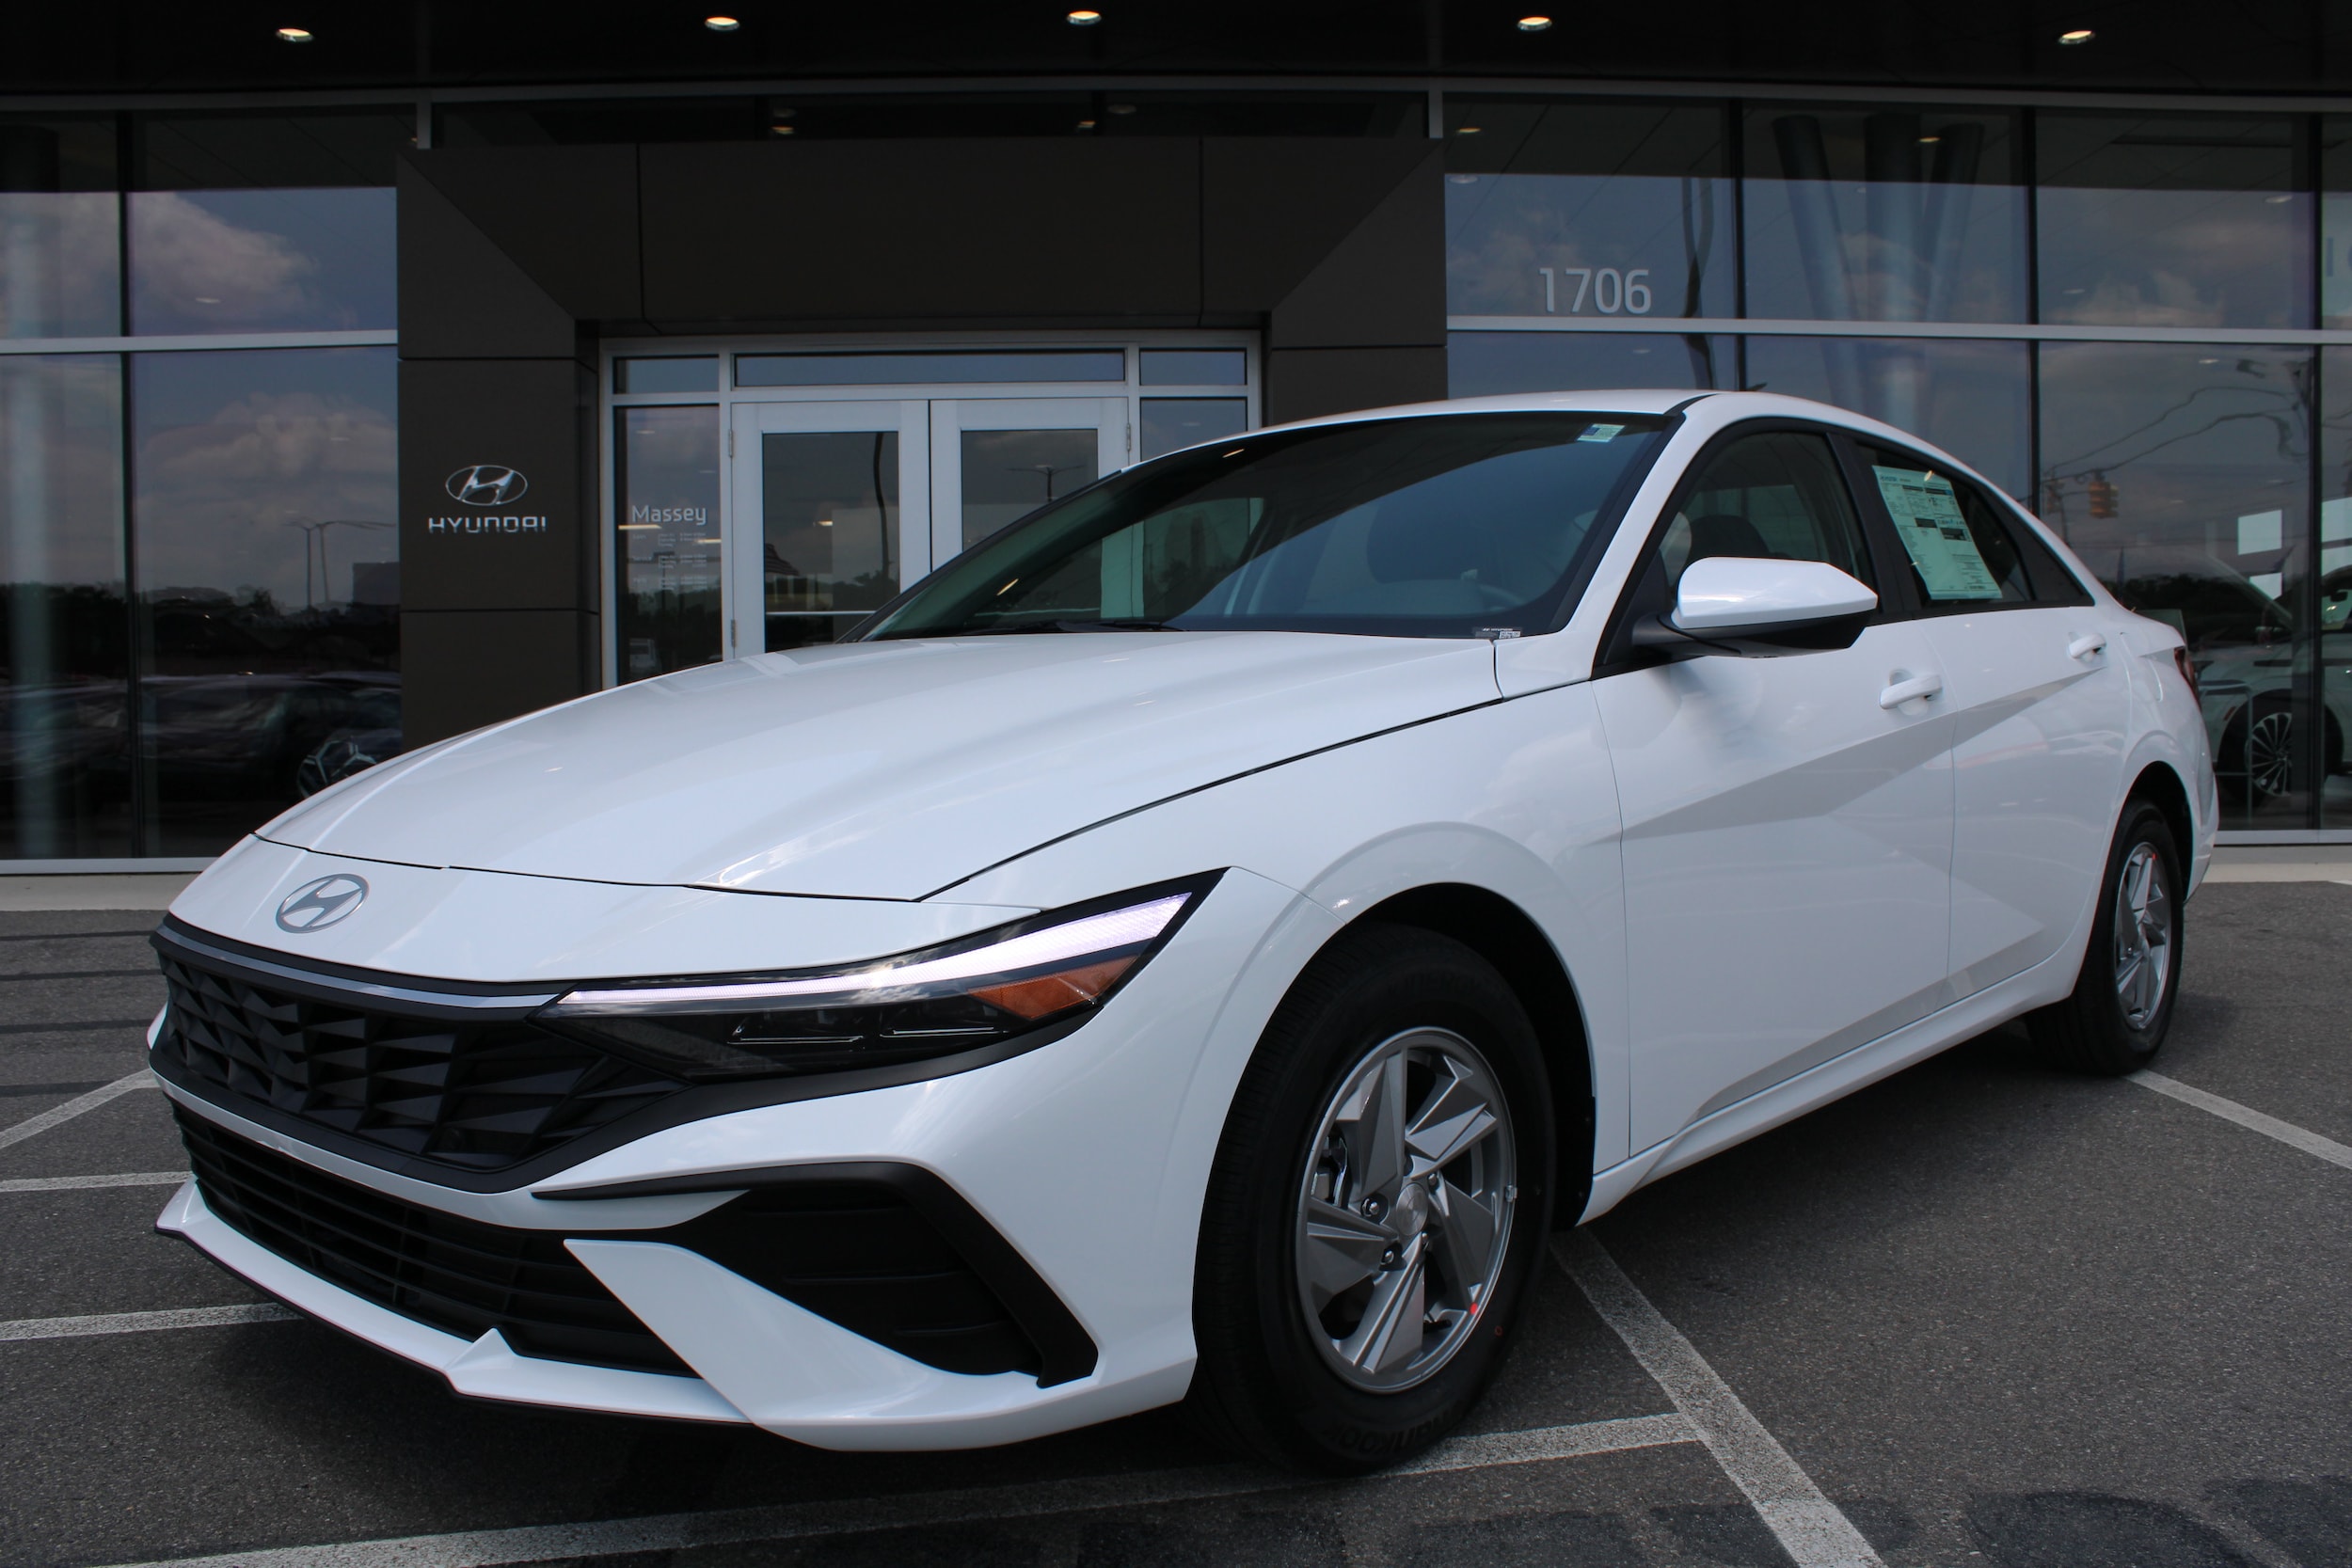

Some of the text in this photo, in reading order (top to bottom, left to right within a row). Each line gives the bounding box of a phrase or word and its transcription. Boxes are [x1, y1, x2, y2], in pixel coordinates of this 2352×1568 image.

[1539, 267, 1652, 314] 1706
[428, 516, 546, 533] HYUNDAI
[632, 505, 707, 526] Massey
